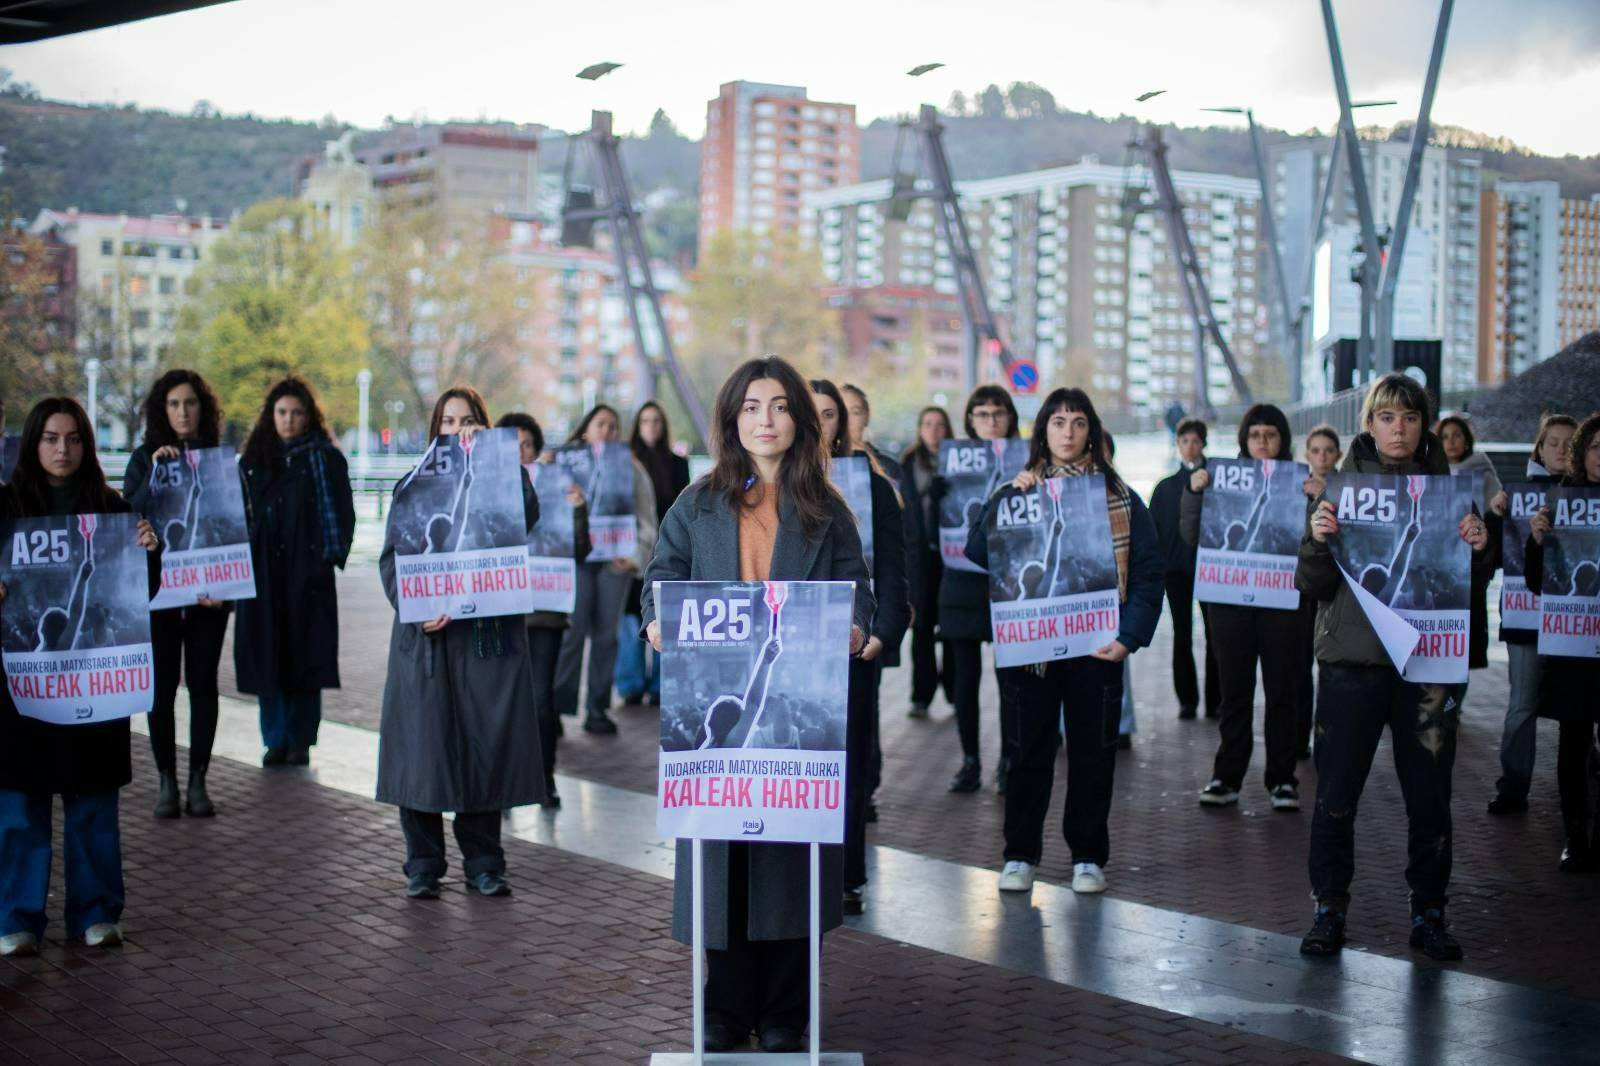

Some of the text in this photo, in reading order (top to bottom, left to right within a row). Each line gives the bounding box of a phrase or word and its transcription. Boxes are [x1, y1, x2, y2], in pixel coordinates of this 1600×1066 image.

[946, 448, 987, 472] A25
[1214, 464, 1255, 490] A25
[996, 494, 1042, 526] A25
[1338, 486, 1396, 522] A25
[1554, 498, 1600, 527] A25
[11, 529, 70, 566] A25
[204, 560, 250, 584] HARTU
[400, 562, 444, 576] INDARKERIA
[500, 555, 526, 567] AURKA
[1198, 564, 1249, 586] KALEAK
[401, 567, 528, 599] KALEAK HARTU
[1092, 598, 1115, 610] AURKA
[1505, 593, 1540, 611] KALE
[1544, 602, 1586, 614] INDARKERIA
[678, 598, 751, 640] A25
[996, 610, 1117, 644] KALEAK HARTU
[1438, 620, 1466, 632] AURKA
[1411, 633, 1466, 658] ARTU
[7, 652, 149, 674] INDARKERIA MATXISTAREN AURKA
[9, 667, 150, 700] KALEAK HARTU
[664, 759, 840, 777] INDARKERIA MATXISTAREN AURKA
[663, 776, 840, 810] KALEAK HARTU
[742, 819, 760, 830] itaia
